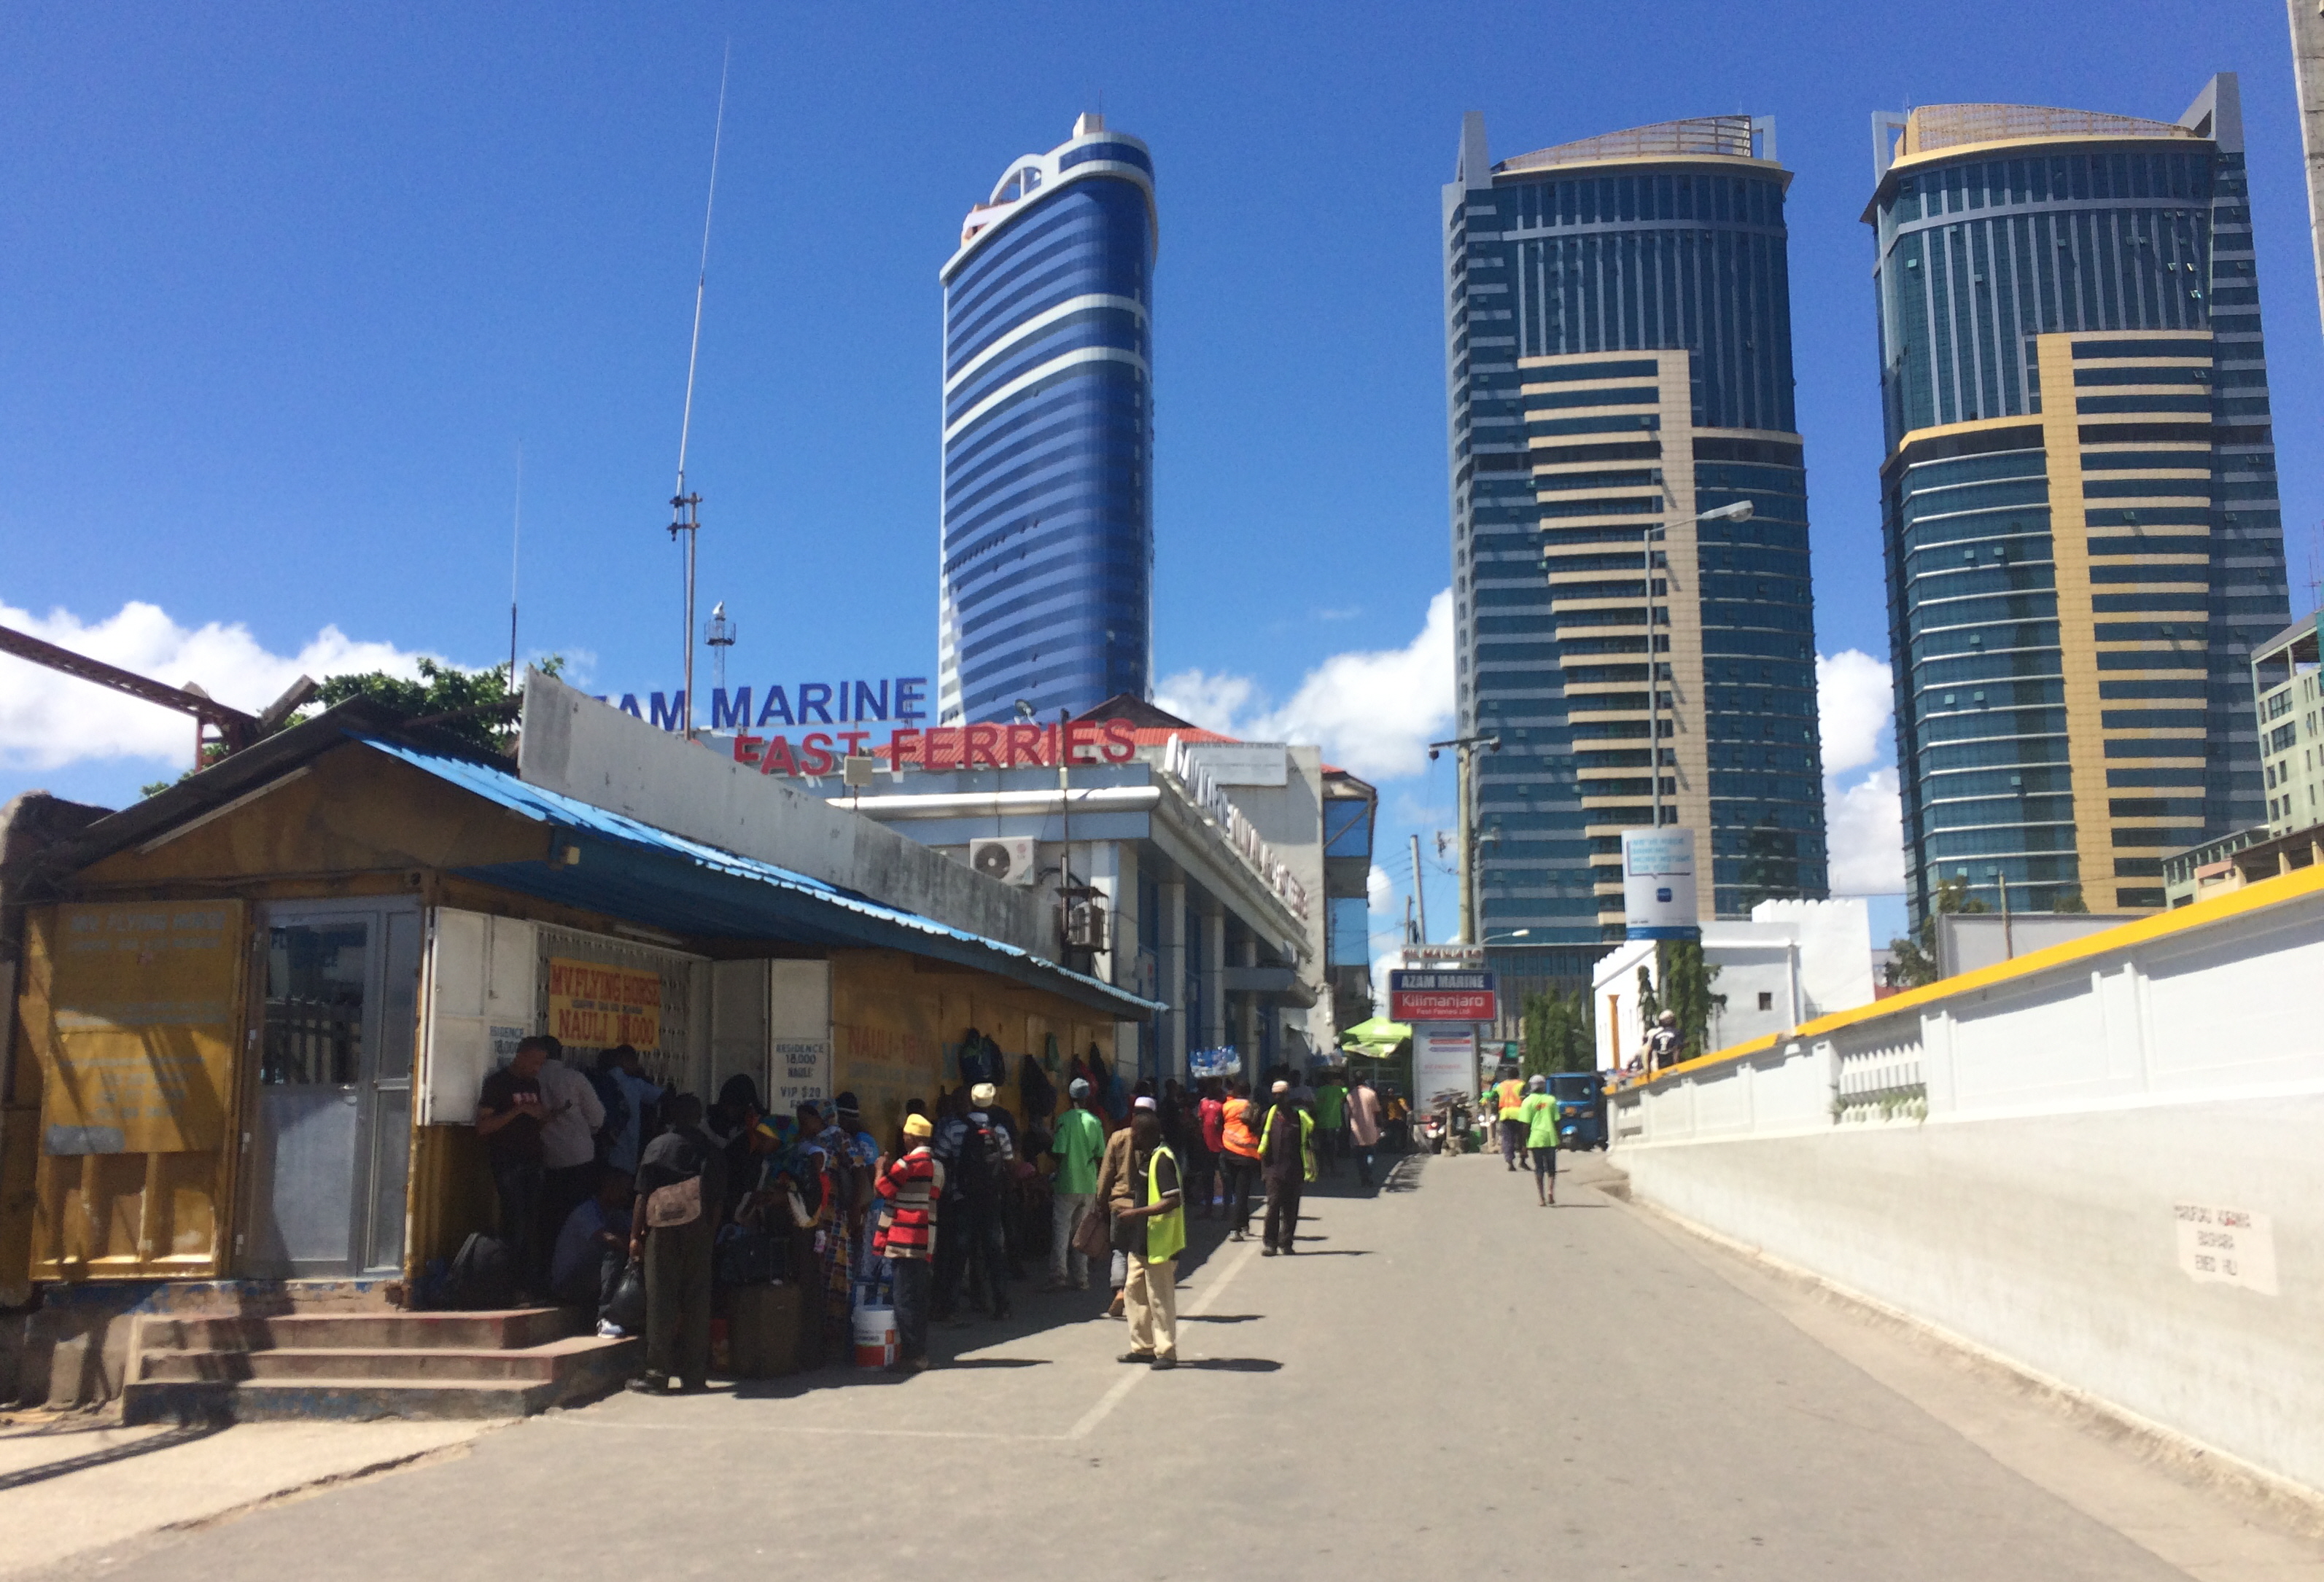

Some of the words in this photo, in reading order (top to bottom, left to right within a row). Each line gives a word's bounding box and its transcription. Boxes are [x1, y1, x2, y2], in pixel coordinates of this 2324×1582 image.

[712, 677, 928, 728] MARINE
[890, 717, 1137, 773] FERRIES
[1402, 975, 1435, 989] AZAM
[1437, 975, 1485, 989] MARINE
[1402, 994, 1485, 1008] Kilimanjaro
[559, 1008, 608, 1042] NAULI
[776, 1044, 824, 1053] RESIDENCE
[780, 1086, 798, 1097] VIP
